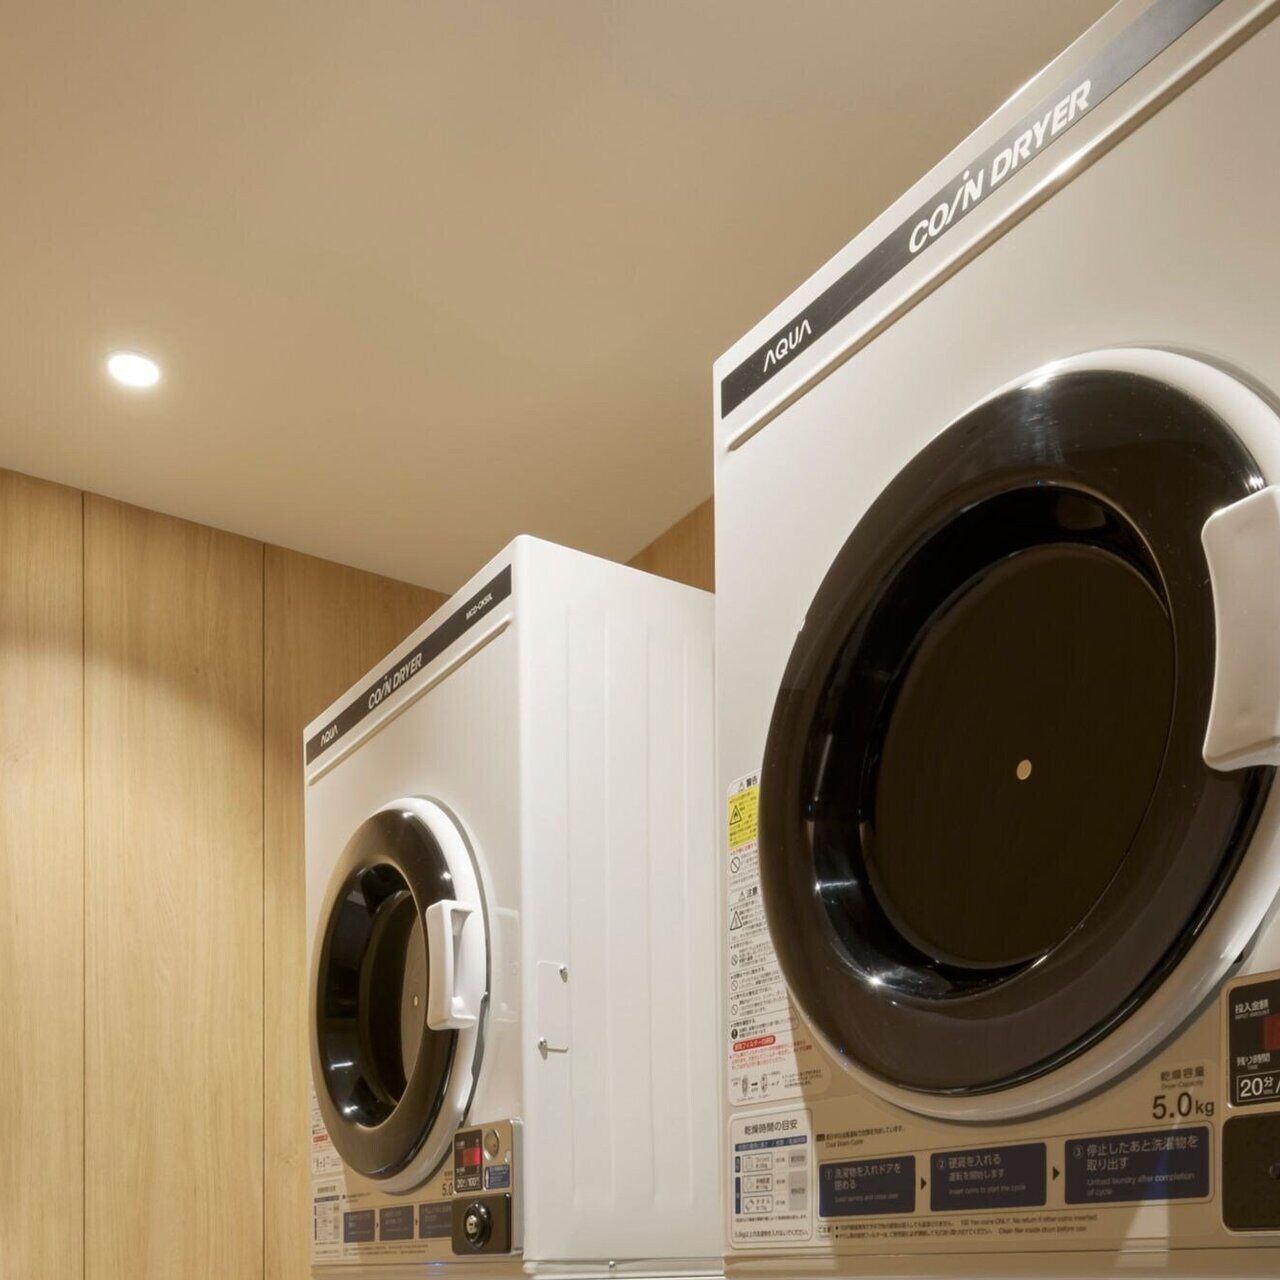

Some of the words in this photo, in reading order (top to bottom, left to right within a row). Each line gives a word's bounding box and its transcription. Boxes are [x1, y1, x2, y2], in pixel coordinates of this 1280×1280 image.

[909, 170, 984, 253] COIN
[991, 80, 1091, 187] DRYER
[763, 319, 812, 373] AQUA
[368, 675, 392, 710] COIN
[393, 652, 422, 689] DRYER
[321, 725, 339, 747] AQUA
[1235, 999, 1269, 1015] 投入金額
[1236, 1052, 1270, 1067] 残り時間
[1161, 1066, 1205, 1081] 乾燥容量
[744, 1119, 798, 1136] 乾燥時間の目安
[1086, 1135, 1199, 1157] 停止したあと洗濯物を
[1087, 1157, 1129, 1171] 取り出す
[1112, 1176, 1137, 1186] laundry
[1138, 1175, 1153, 1183] after
[1154, 1172, 1195, 1183] completion
